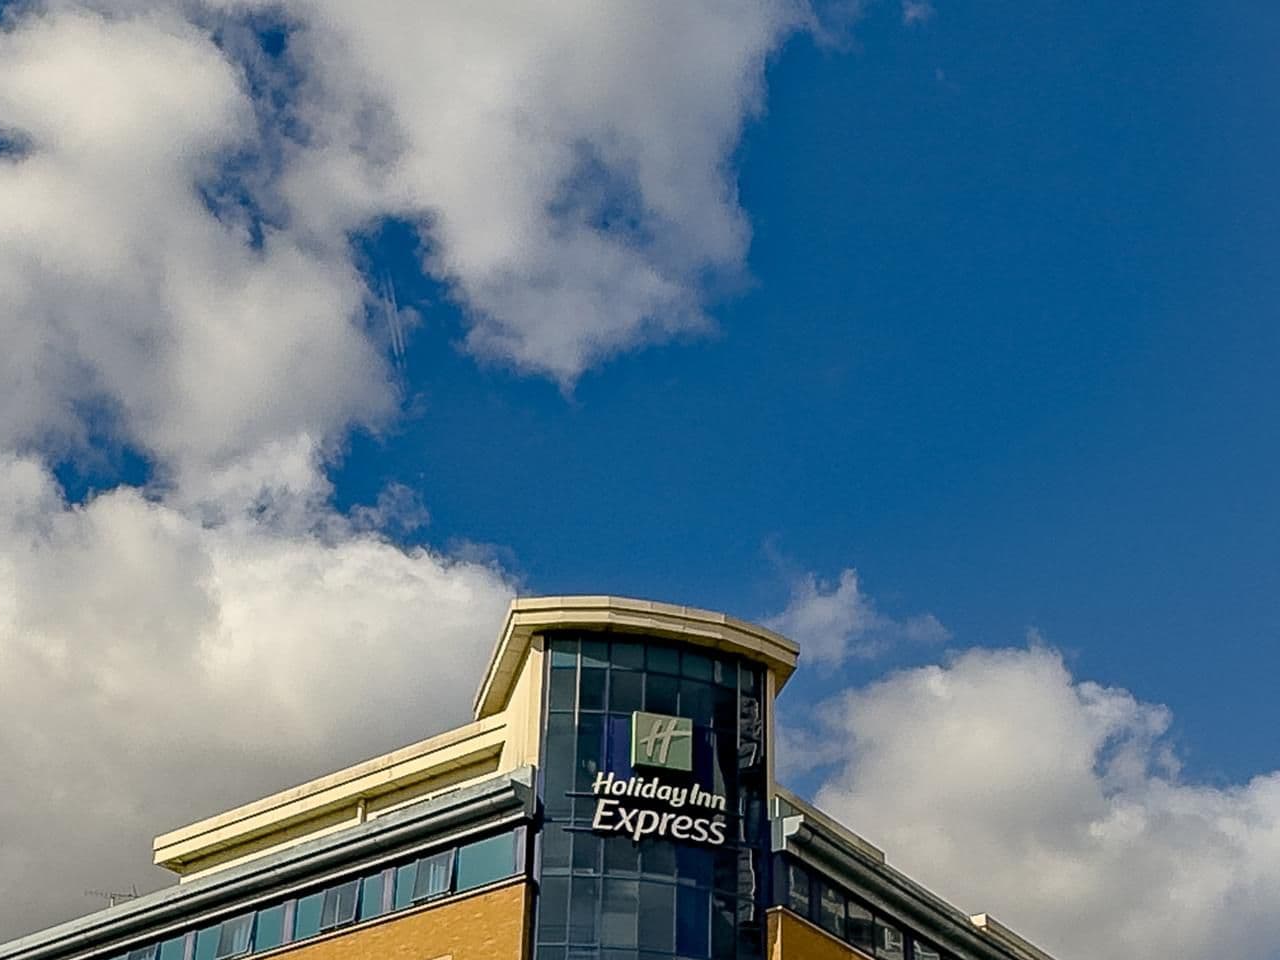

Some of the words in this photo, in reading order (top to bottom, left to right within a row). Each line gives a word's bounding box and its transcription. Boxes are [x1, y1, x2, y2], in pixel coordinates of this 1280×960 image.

[592, 771, 688, 807] Holiday
[689, 783, 726, 811] Inn
[592, 798, 727, 844] Express
